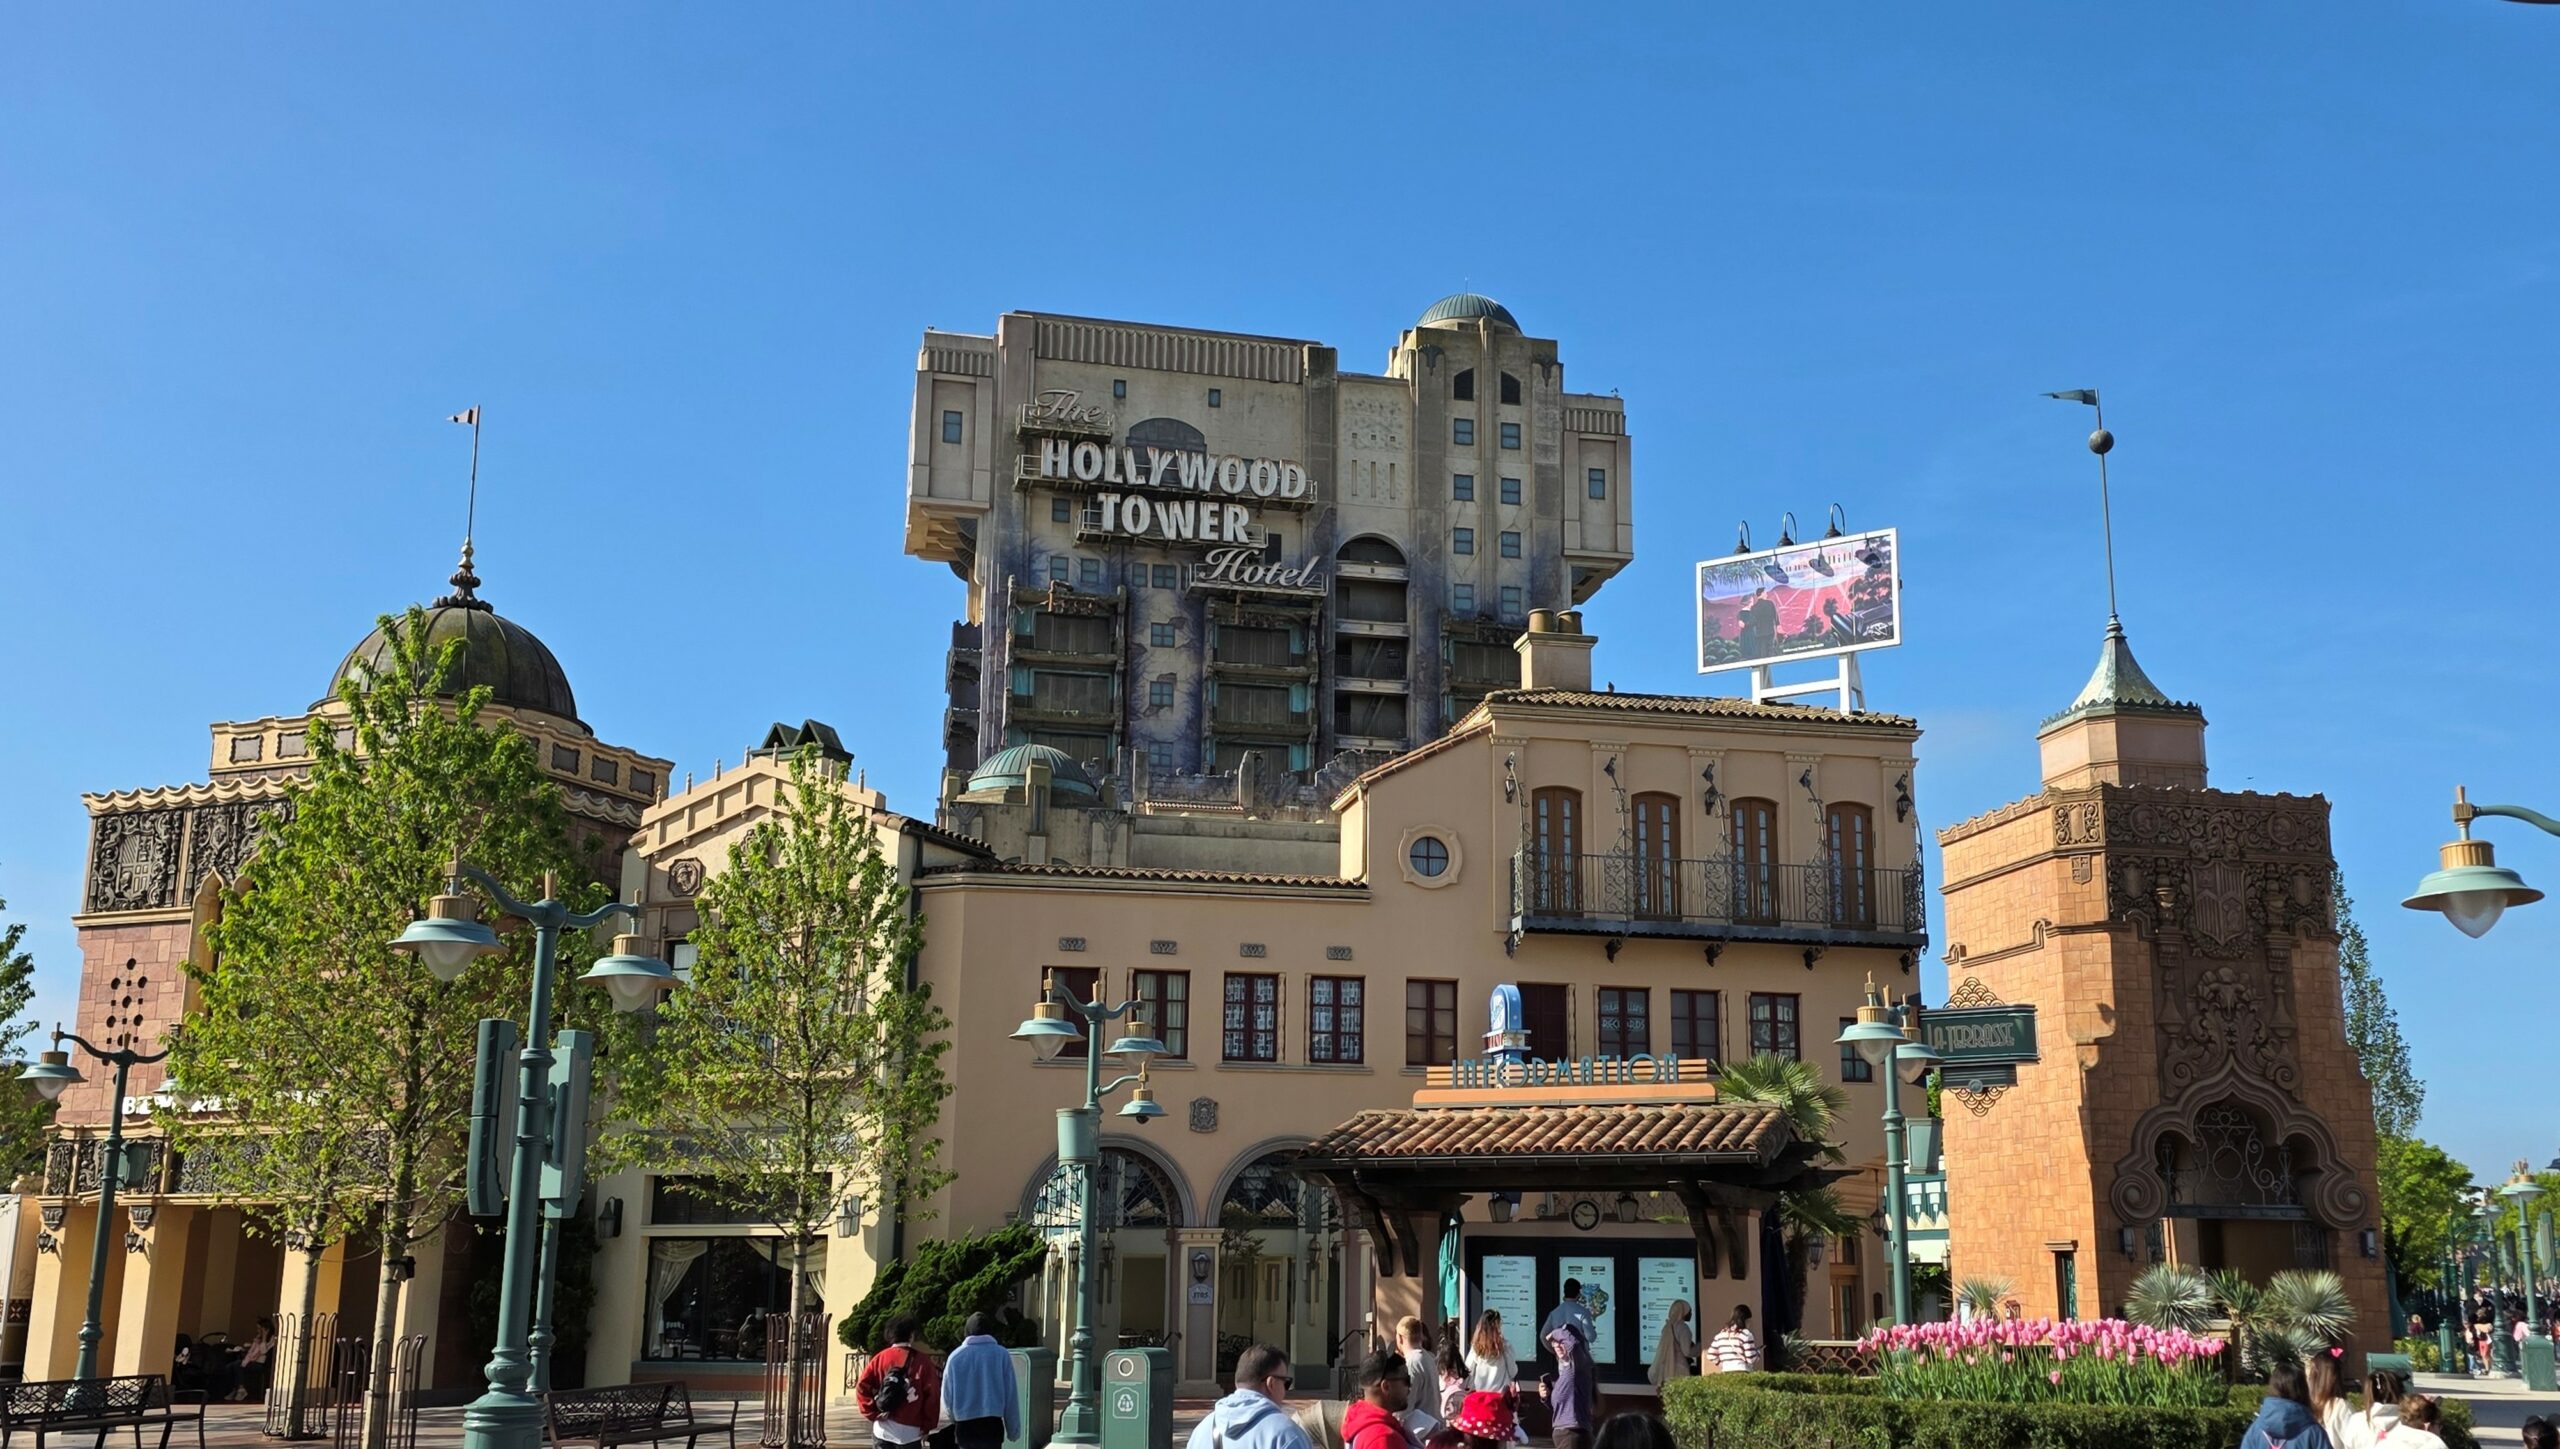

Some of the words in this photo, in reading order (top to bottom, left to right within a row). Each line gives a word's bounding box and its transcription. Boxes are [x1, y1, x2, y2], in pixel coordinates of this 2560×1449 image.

[1032, 389, 1101, 423] The
[1040, 438, 1306, 499] HOLLYWOOD
[1099, 492, 1250, 544] TOWER
[1200, 547, 1320, 588] Hotel
[1946, 1022, 2015, 1053] TERRASSE
[1452, 1053, 1678, 1088] INFORMATION
